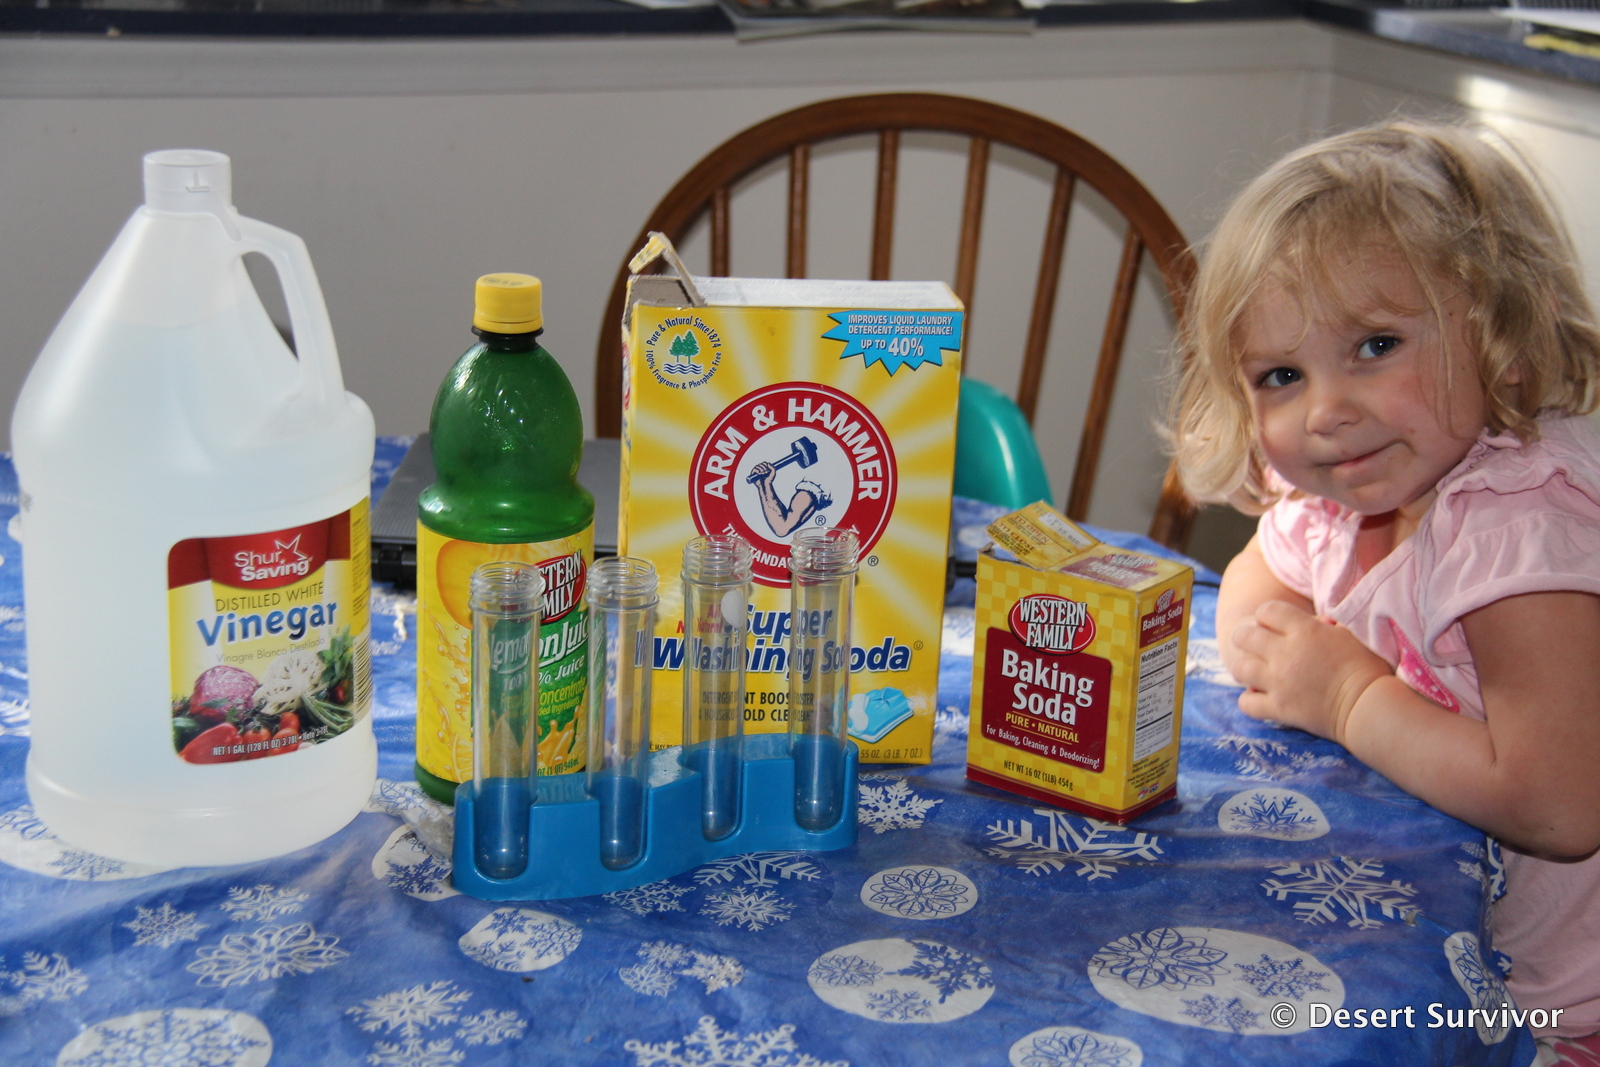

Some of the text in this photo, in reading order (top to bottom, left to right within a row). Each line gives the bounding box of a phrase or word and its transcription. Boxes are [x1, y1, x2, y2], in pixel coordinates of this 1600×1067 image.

[646, 331, 661, 346] Pure
[658, 324, 666, 332] &
[665, 315, 693, 328] Natural
[848, 314, 953, 326] IMPROVES LIQUID LAUNDRY
[848, 325, 954, 336] DETERGENT PERFORMANCE!
[861, 337, 924, 357] UP TO 40%
[646, 350, 722, 390] 100% Fragrance & Phosphate Free
[704, 426, 749, 500] ARM
[752, 404, 778, 432] &
[787, 398, 883, 501] HAMMER
[1010, 530, 1036, 552] CLOSE
[1026, 524, 1050, 543] OPEN
[235, 550, 282, 568] Shur
[241, 560, 309, 582] Saving
[215, 582, 324, 612] DISTILLED WHITE
[196, 602, 337, 647] Vinegar
[1020, 598, 1087, 626] WESTERN
[1143, 614, 1166, 631] Baking
[1167, 606, 1183, 620] Soda
[1026, 623, 1077, 650] FAMILY
[216, 637, 326, 665] Vinagre Blanco Destilado
[820, 637, 912, 673] Soda
[1140, 648, 1163, 664] Nutrition
[1164, 641, 1178, 653] Facts
[555, 654, 584, 680] Juice
[1002, 649, 1094, 708] Baking
[1012, 683, 1077, 725] Soda
[1005, 712, 1079, 743] PURE NATURAL
[213, 746, 226, 756] NET
[227, 746, 231, 754] 1
[233, 744, 245, 754] GAL
[247, 743, 262, 753] (128
[263, 742, 270, 750] FL
[271, 739, 281, 749] OZ)
[861, 749, 870, 759] 55
[884, 749, 891, 759] (3
[904, 748, 909, 758] 7
[986, 724, 1100, 769] For Baking, Cleaning & Deodorizing!
[1003, 760, 1015, 771] NET
[1016, 764, 1024, 774] WT
[1025, 767, 1032, 776] 16
[1034, 770, 1041, 779] OZ
[1042, 772, 1057, 785] (1LB)
